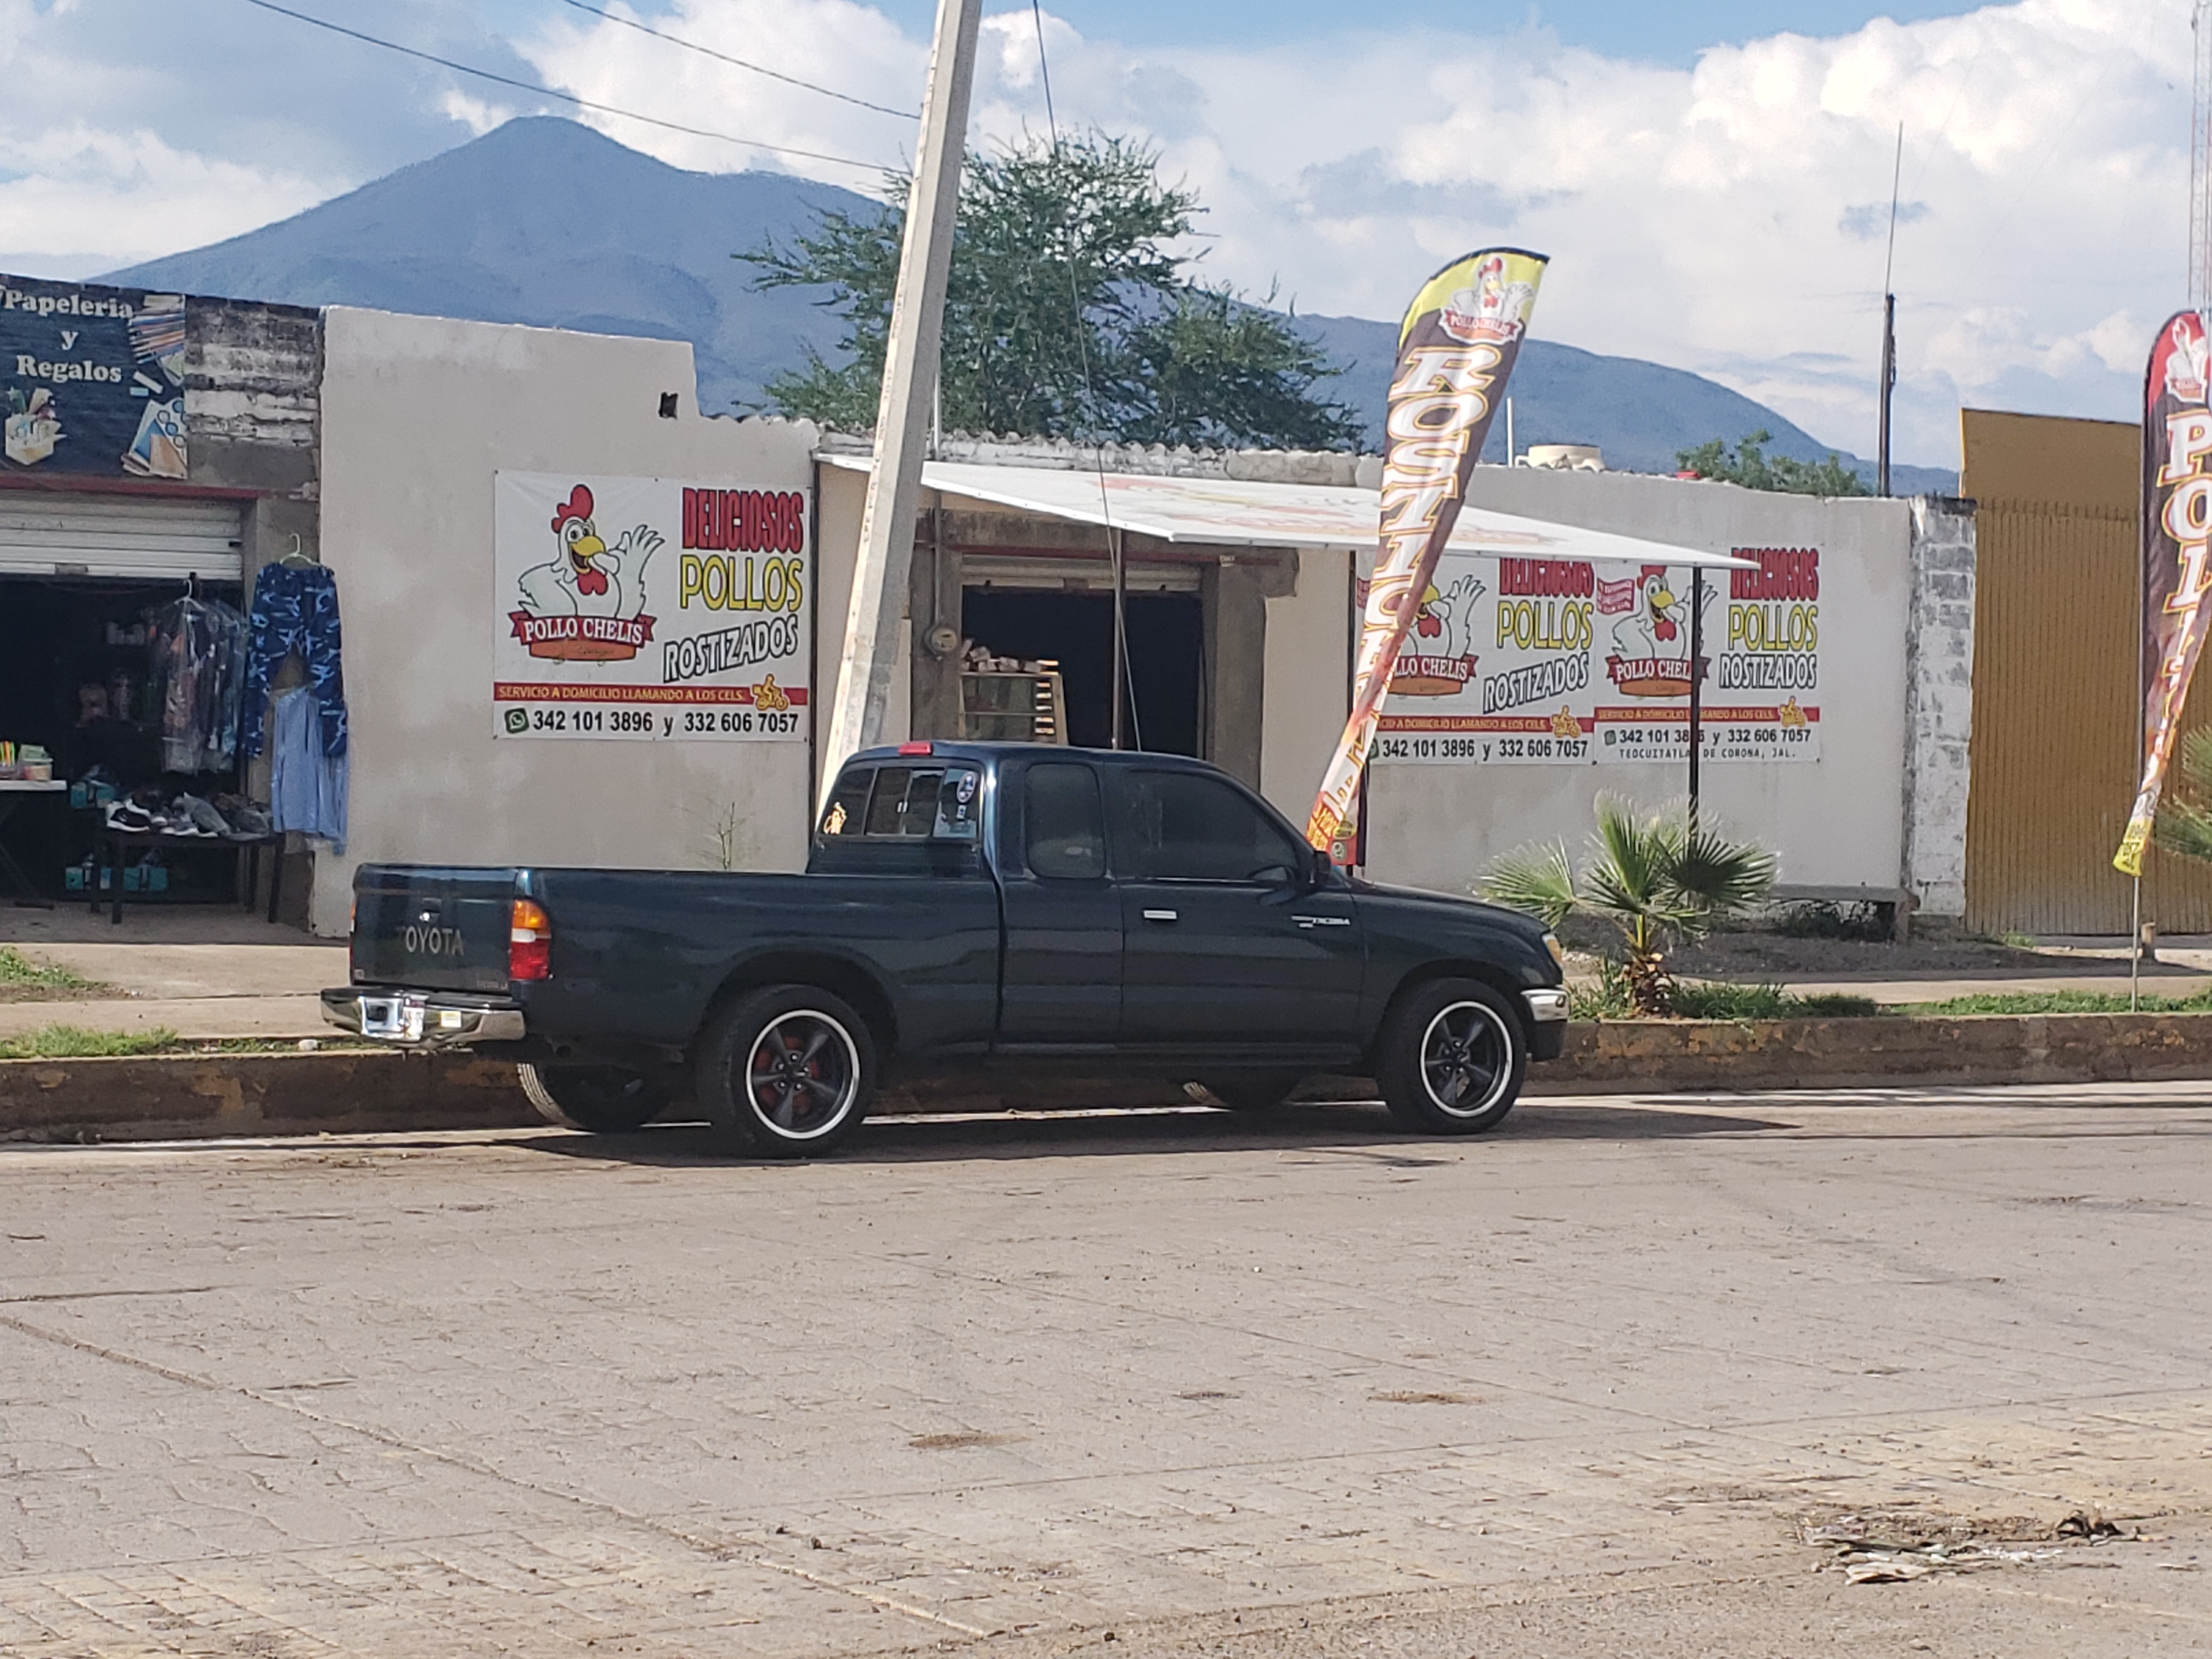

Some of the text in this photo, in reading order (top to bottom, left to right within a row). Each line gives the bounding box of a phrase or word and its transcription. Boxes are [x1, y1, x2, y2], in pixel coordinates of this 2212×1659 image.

[60, 330, 80, 351] y
[16, 354, 122, 383] Regalos
[682, 487, 804, 554] DELICIOSOS
[680, 555, 804, 612] POLLOS
[525, 618, 644, 645] POLLO CHELIS
[1497, 600, 1594, 650] POLLOS
[1729, 604, 1818, 651] POLLOS
[663, 613, 798, 684] ROSTIZADOS
[1395, 658, 1467, 680] LLO CHELIS
[1616, 660, 1691, 681] POLLO CHEL
[1719, 654, 1816, 689] ROSTIZADOS
[499, 686, 549, 698] SERVICIO
[552, 687, 560, 698] A
[563, 687, 620, 699] DOMICILIO
[623, 689, 683, 701] LLAMANDO
[686, 690, 694, 701] A
[696, 690, 715, 701] LOS
[1483, 652, 1589, 714] ROSTIZADOS
[533, 711, 799, 736] 342 101 3896 y 332 606 7057
[1397, 719, 1403, 729] A
[1500, 719, 1507, 728] A
[1635, 709, 1641, 719] A
[1620, 729, 1811, 746] 342 101 386 y 332 606 7057
[1383, 740, 1588, 761] 342 101 3896 y 332 606 7057
[1703, 748, 1716, 758] DE
[1773, 748, 1796, 758] JAL.
